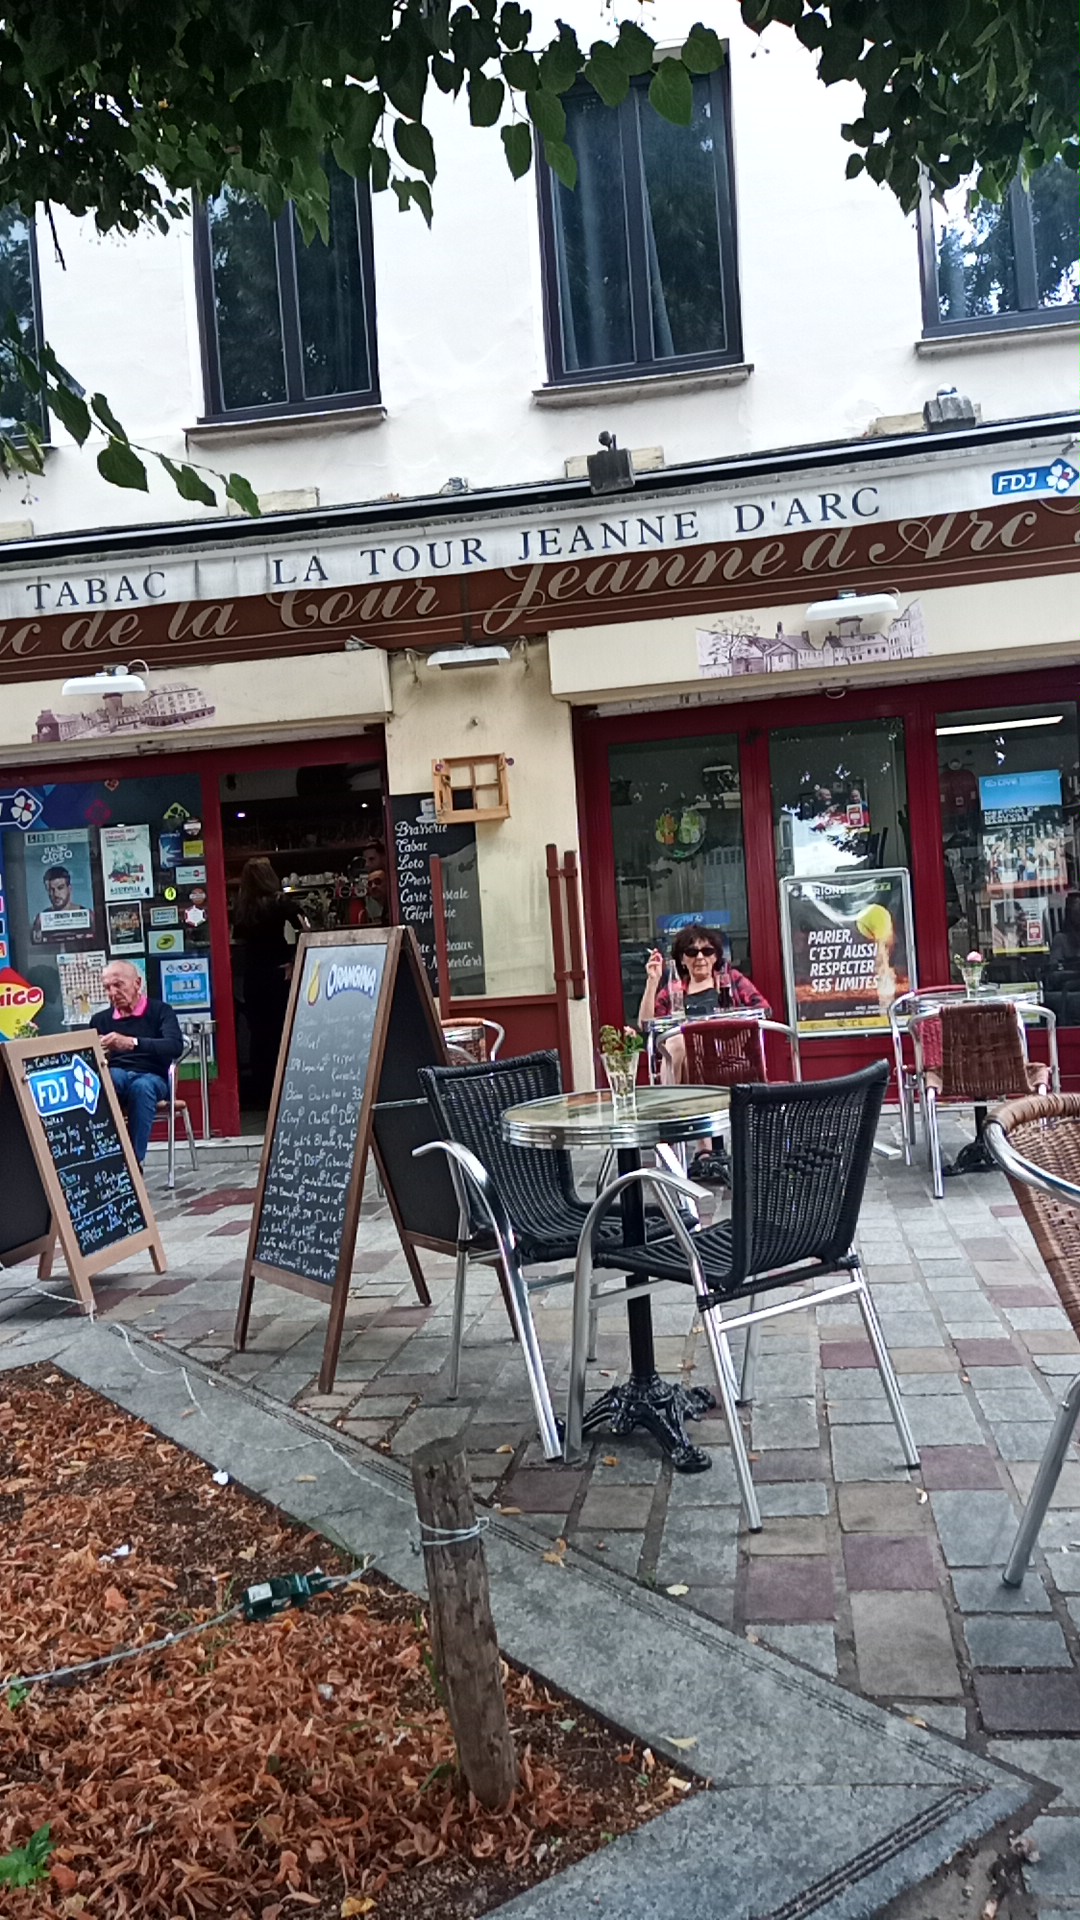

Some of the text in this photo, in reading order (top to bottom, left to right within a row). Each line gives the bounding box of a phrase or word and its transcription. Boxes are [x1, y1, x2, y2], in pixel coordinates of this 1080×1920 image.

[997, 472, 1037, 492] FDJ
[26, 487, 880, 610] TABAC LA TOUR JEANNE D'ARC
[61, 611, 143, 650] de
[167, 602, 238, 641] la
[482, 541, 787, 635] Jeanne
[394, 821, 448, 836] Brasserie
[395, 838, 428, 853] Tabac
[397, 854, 424, 870] Loto
[399, 871, 432, 887] Press
[400, 888, 427, 904] Carte
[433, 938, 474, 952] deaux
[808, 929, 853, 945] PARIER,
[809, 942, 878, 961] C'EST AUSSI
[428, 955, 482, 969] MsterCard
[809, 959, 875, 977] RESPECTER
[183, 980, 195, 990] 11
[326, 964, 377, 999] ORANGINA
[811, 975, 880, 992] SES LIMITES
[37, 1076, 69, 1108] FDJ
